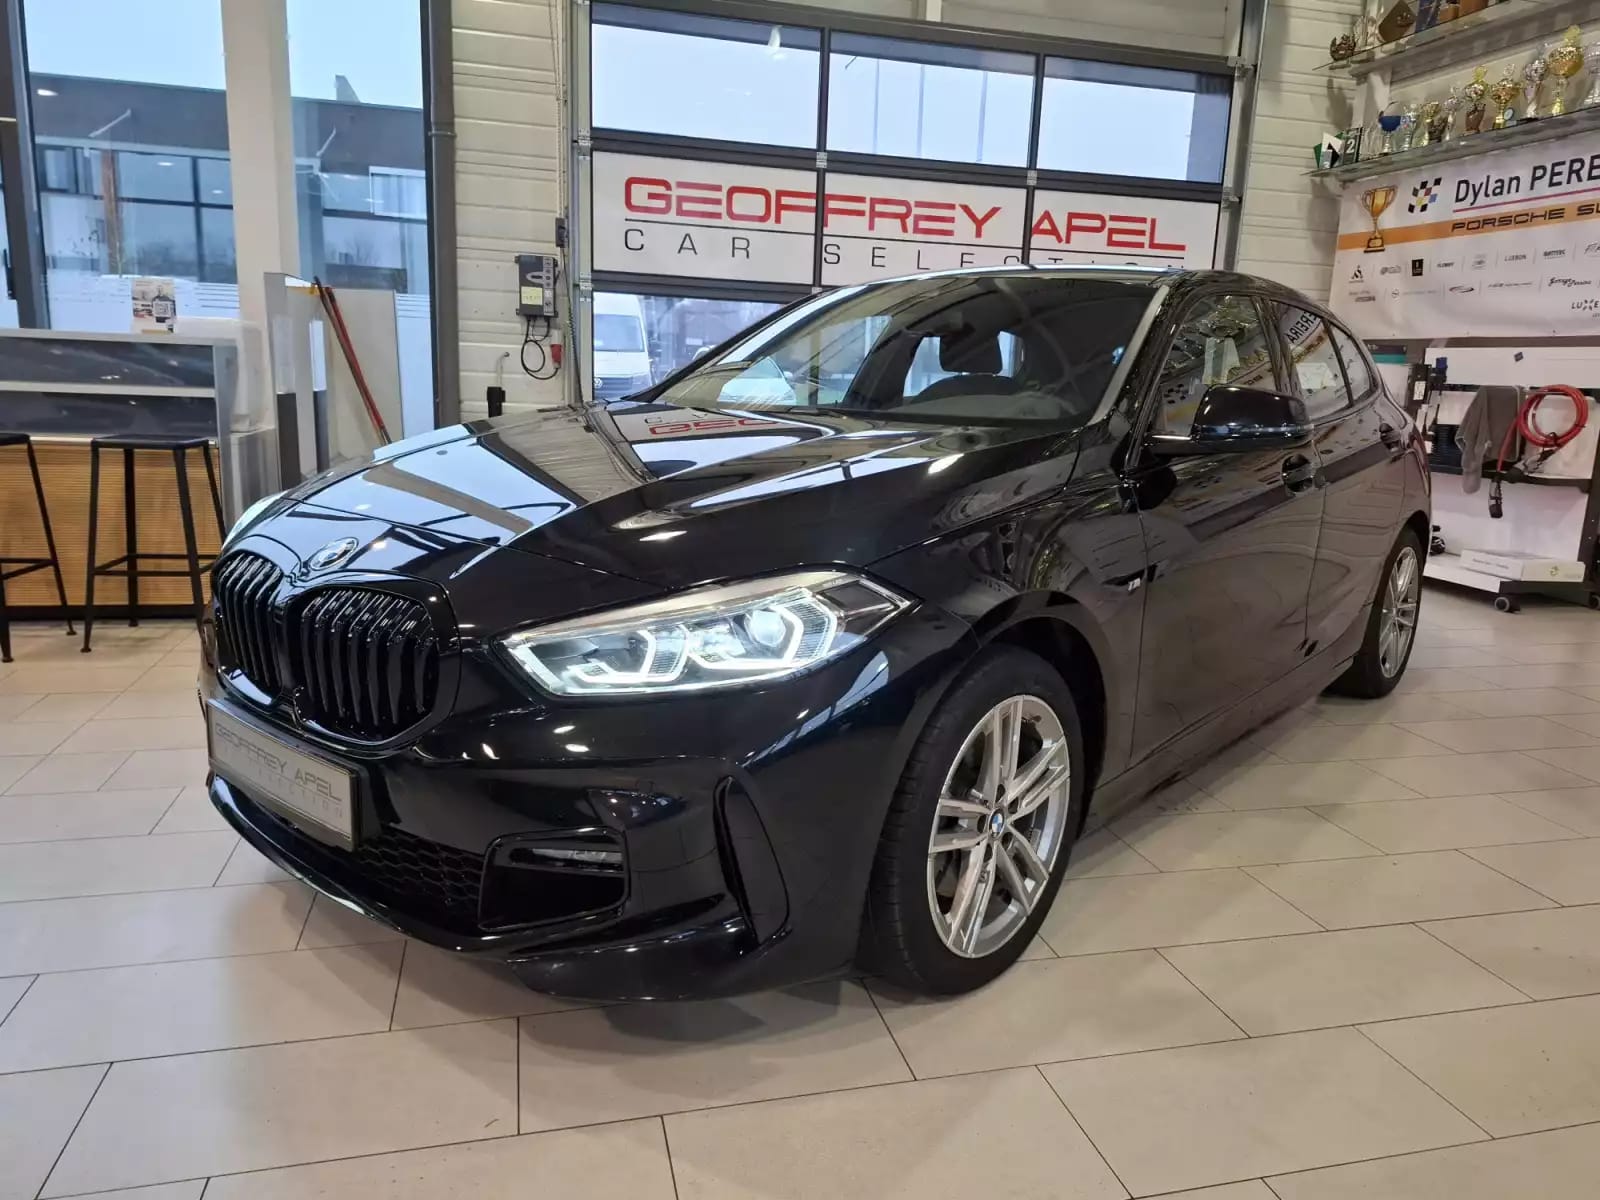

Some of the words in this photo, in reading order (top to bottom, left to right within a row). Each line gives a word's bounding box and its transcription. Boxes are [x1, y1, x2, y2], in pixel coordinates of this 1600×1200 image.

[1455, 174, 1521, 206] Dylan
[1530, 153, 1600, 191] PERE
[624, 176, 1002, 238] GEOFFREY
[1031, 209, 1186, 252] APEL
[1451, 207, 1565, 233] PORSCHE
[624, 228, 750, 260] CAR
[215, 722, 288, 773] GEOFFREY
[294, 767, 343, 802] APEL
